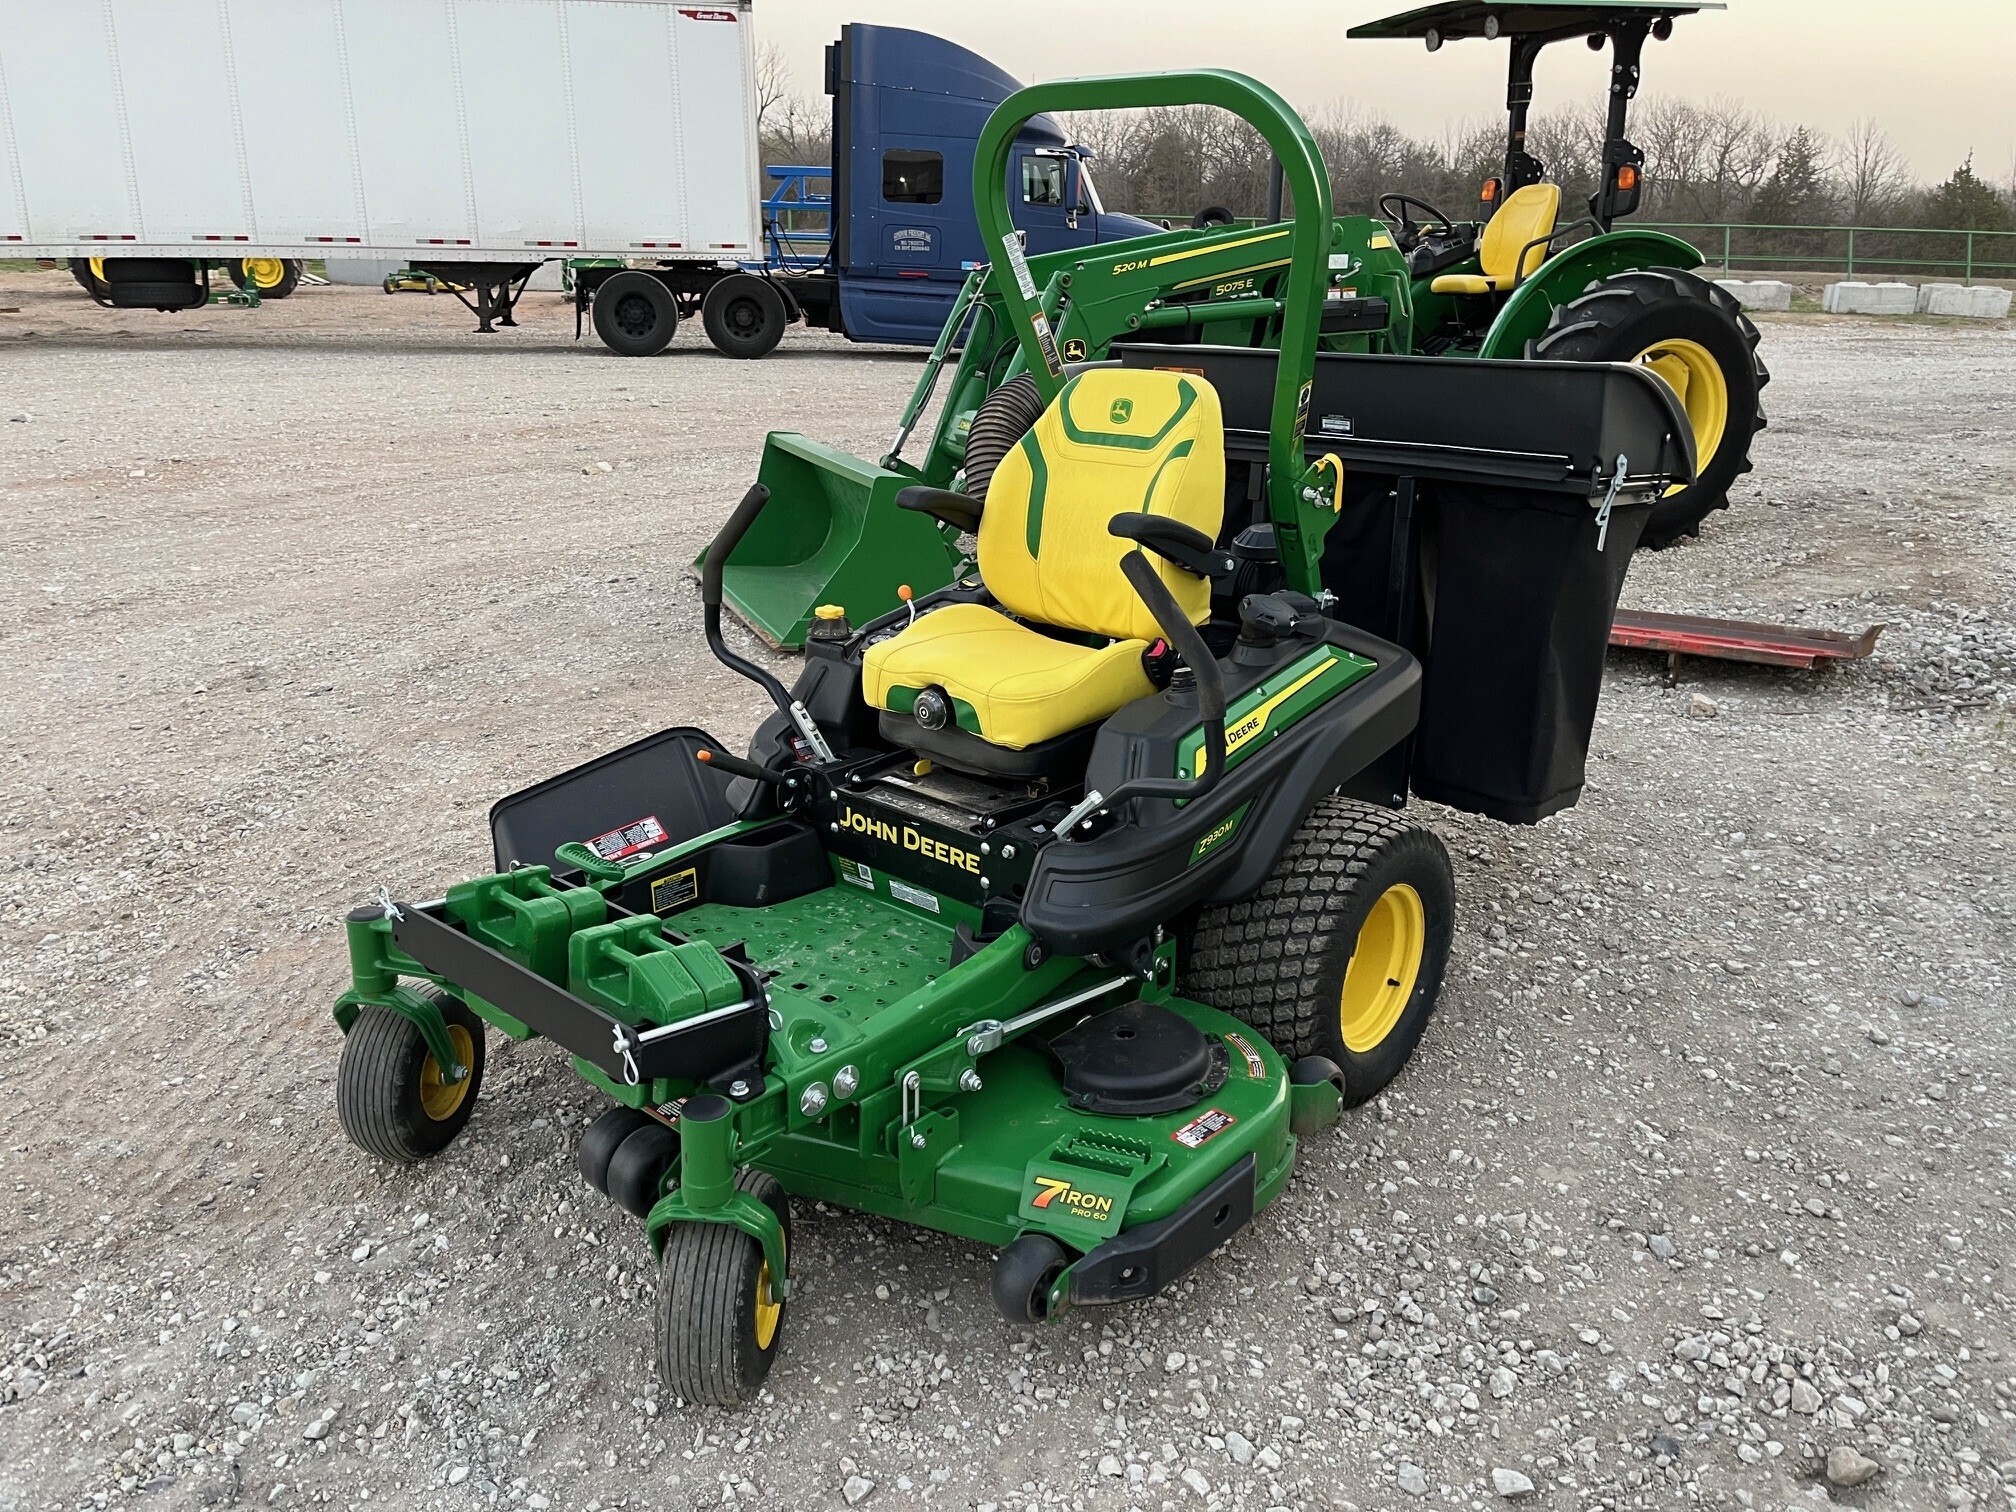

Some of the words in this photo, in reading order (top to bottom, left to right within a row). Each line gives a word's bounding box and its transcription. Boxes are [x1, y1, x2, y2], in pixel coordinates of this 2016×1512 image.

[1215, 281, 1245, 296] 5075
[1228, 717, 1260, 745] DEERE
[839, 806, 898, 845] JOHN
[903, 826, 981, 875] DEERE
[1198, 819, 1234, 855] Z930M
[1070, 1207, 1092, 1218] PRO
[1093, 1212, 1108, 1221] 60
